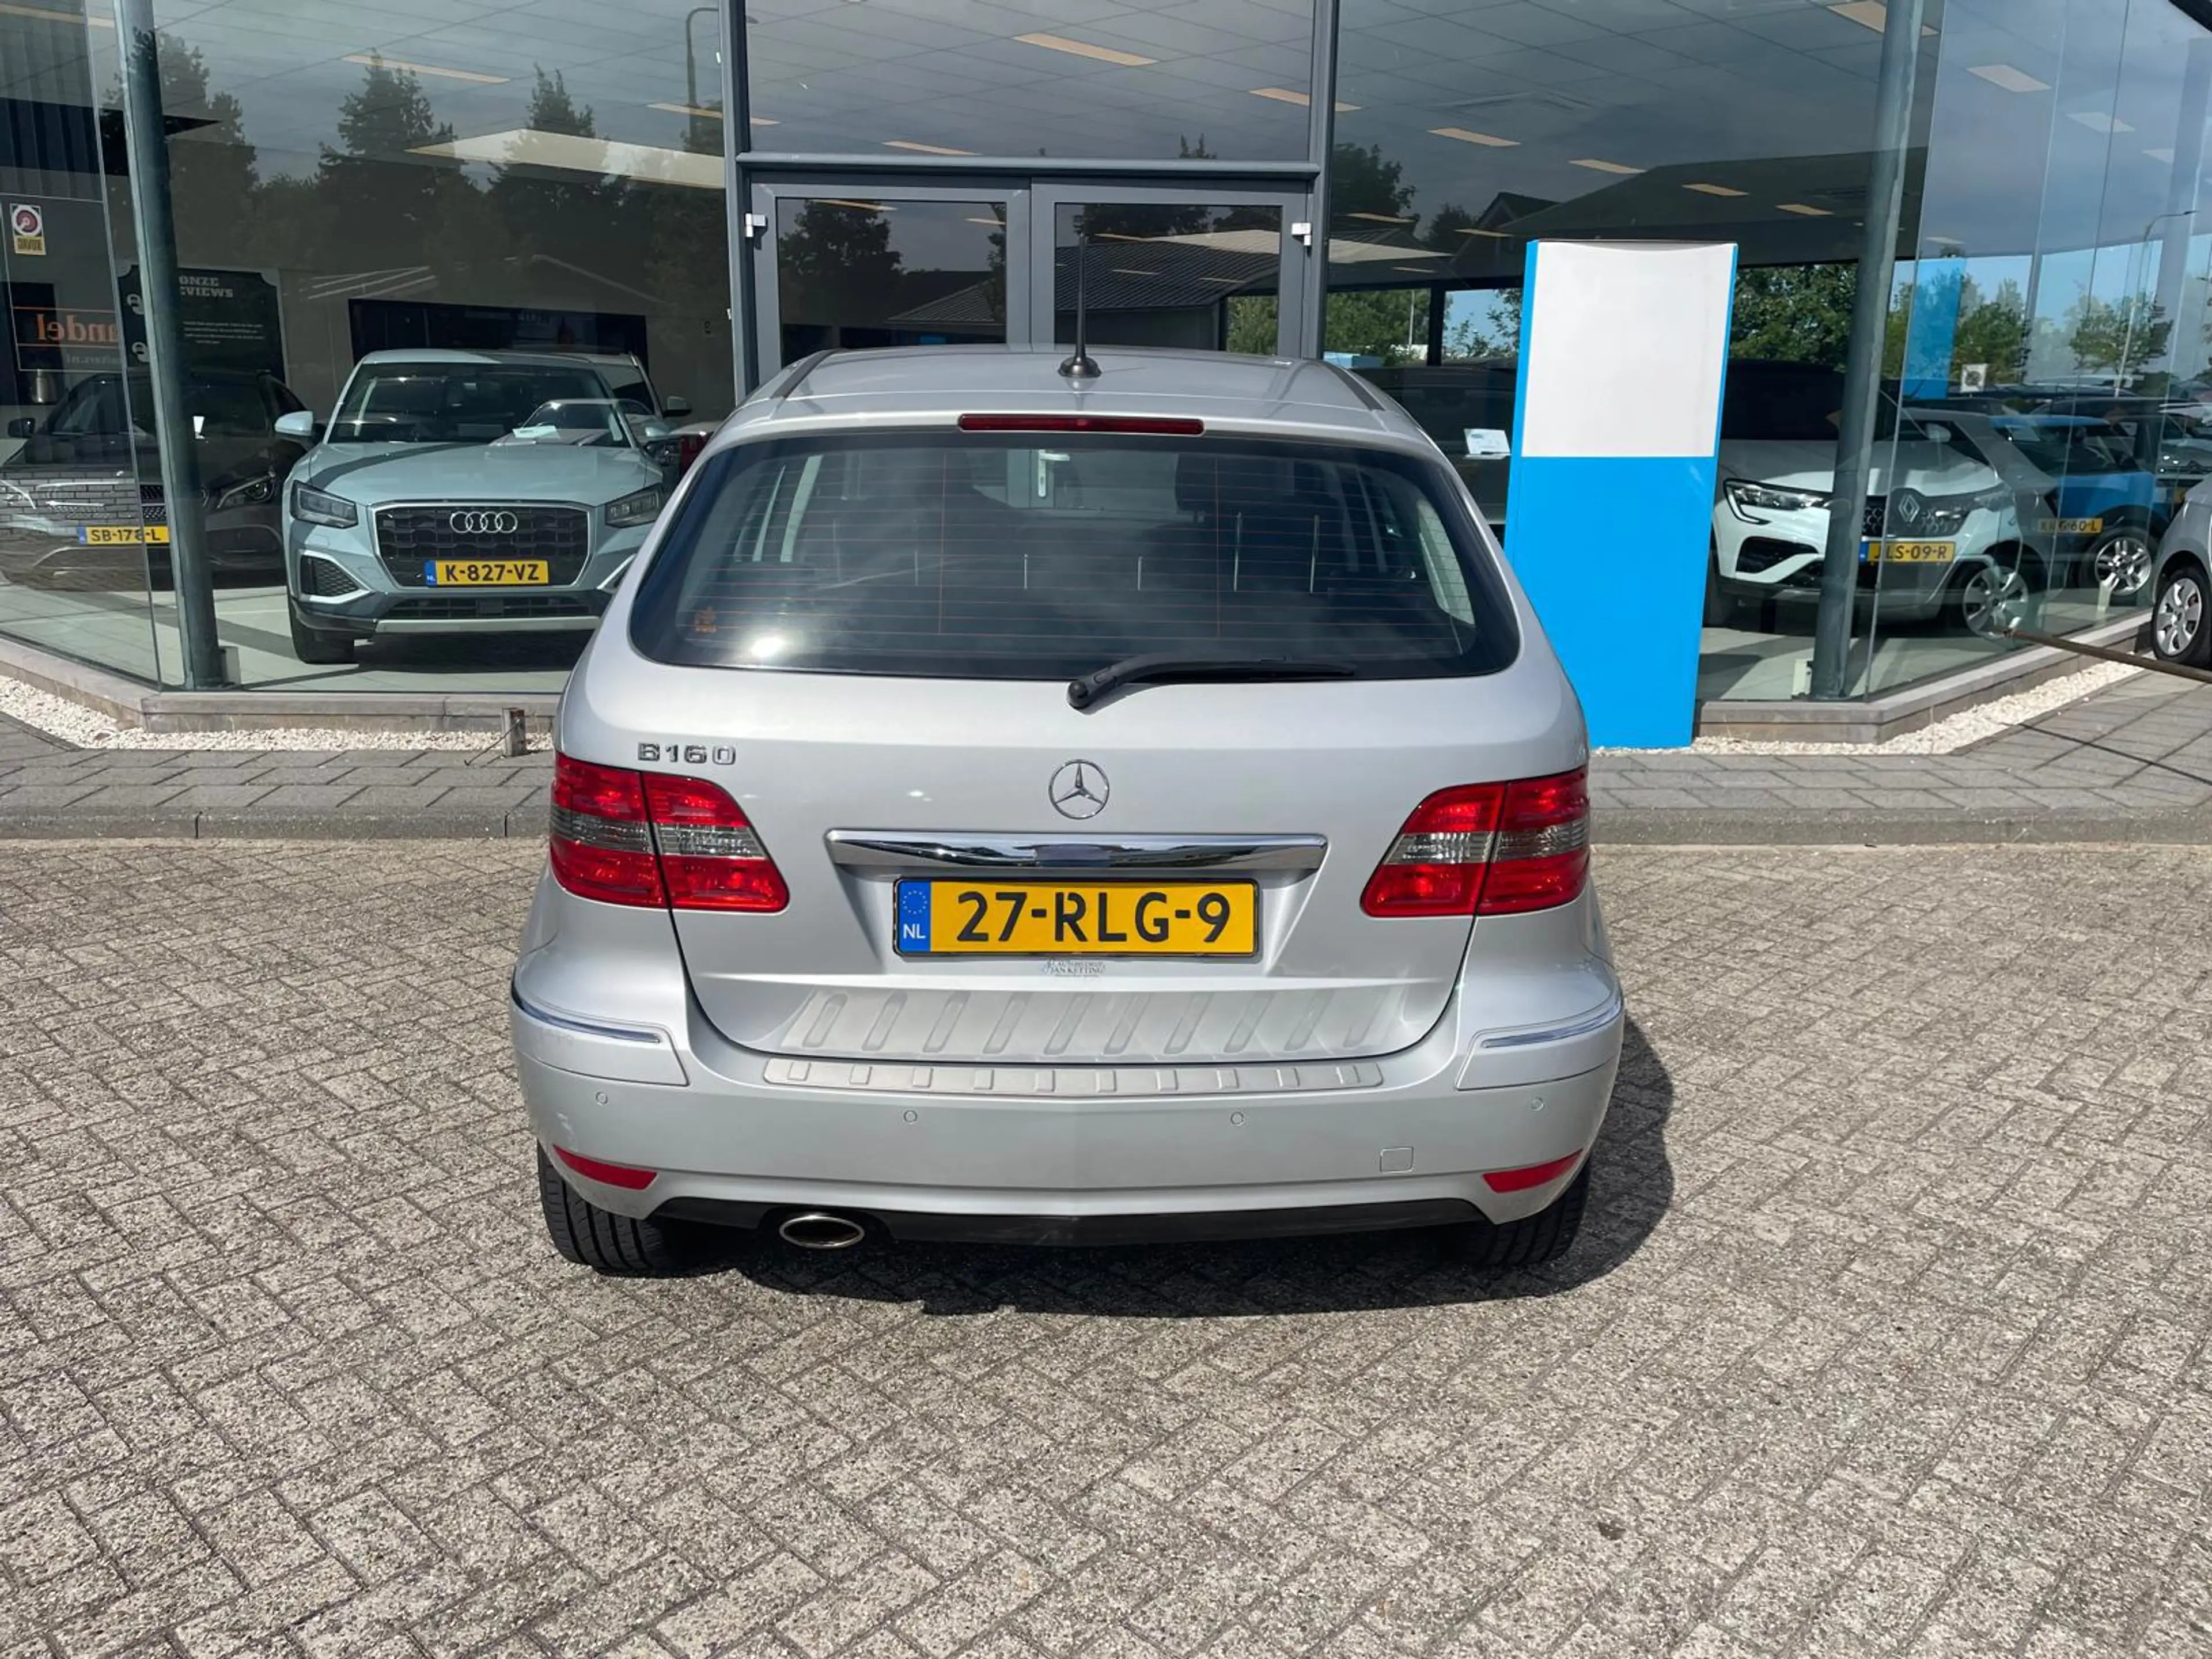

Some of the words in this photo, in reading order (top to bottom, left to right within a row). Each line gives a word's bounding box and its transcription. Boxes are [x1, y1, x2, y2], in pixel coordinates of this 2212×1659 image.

[179, 275, 219, 287] ONZE
[445, 564, 540, 582] K-827-VZ
[637, 743, 737, 766] B160
[956, 891, 1231, 943] 27-RLG-9
[903, 923, 926, 940] NL
